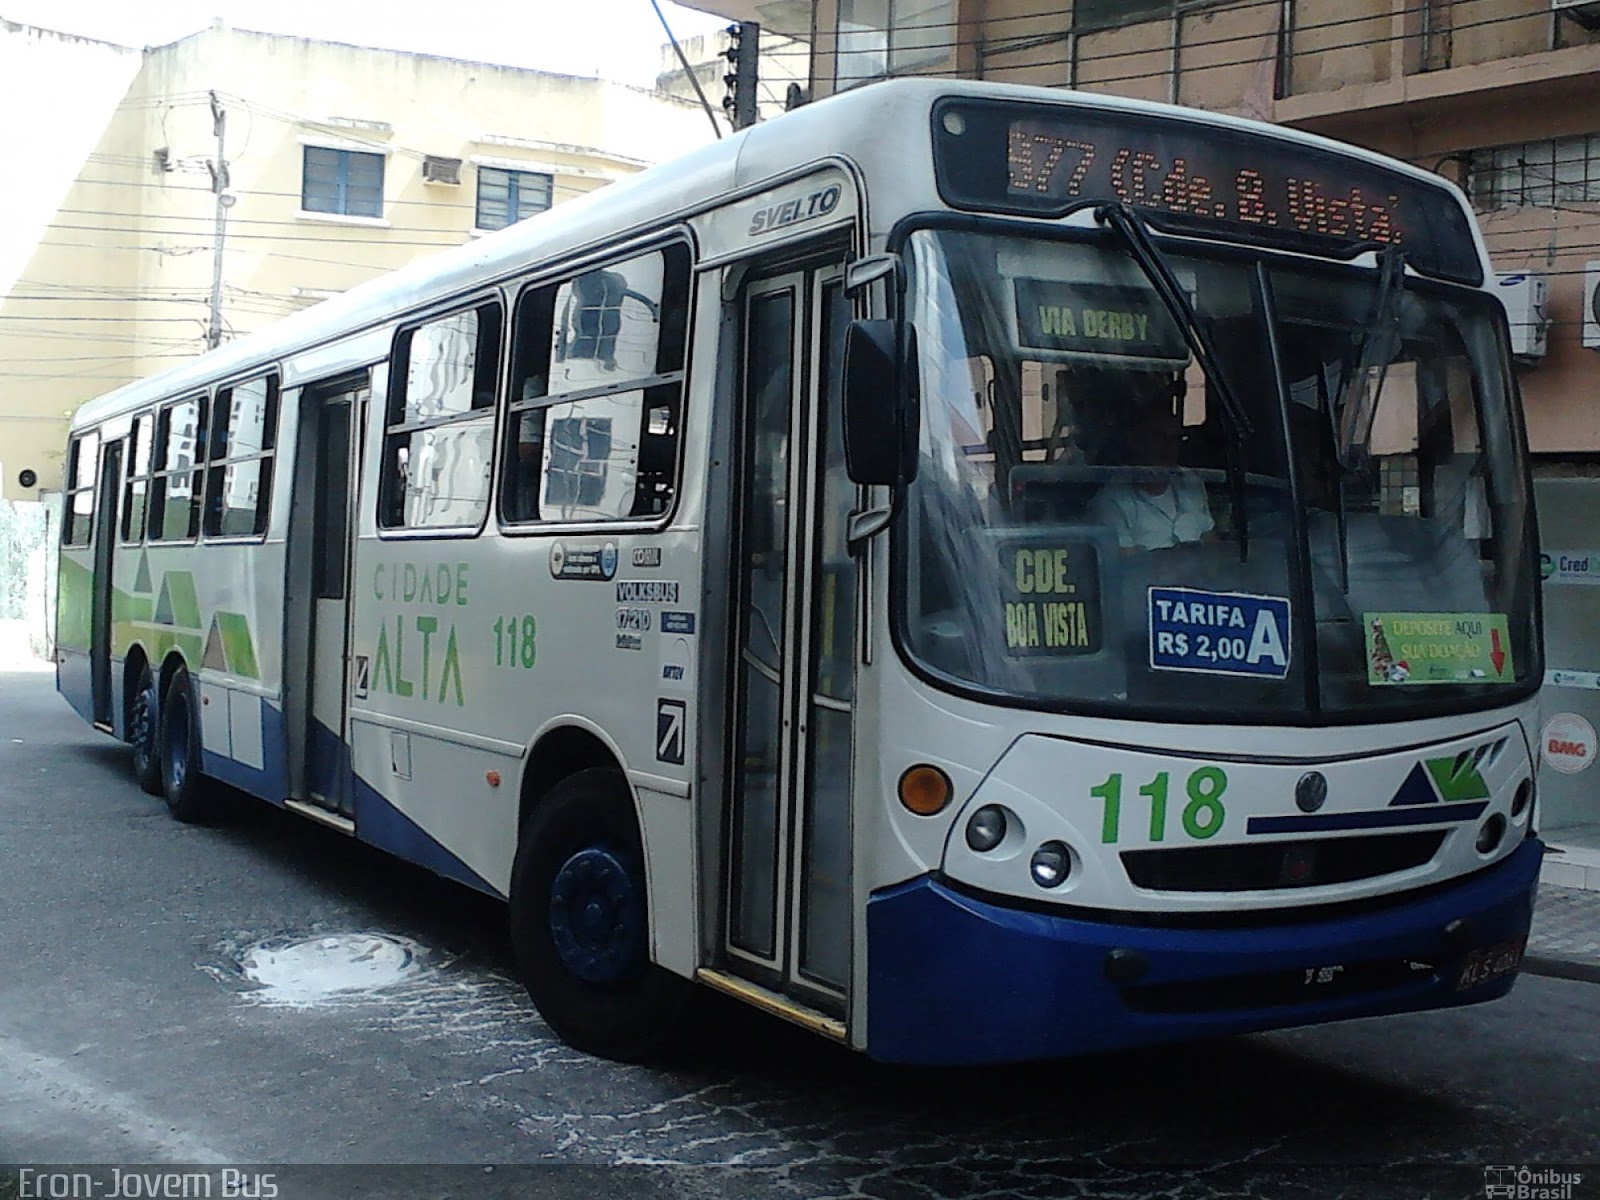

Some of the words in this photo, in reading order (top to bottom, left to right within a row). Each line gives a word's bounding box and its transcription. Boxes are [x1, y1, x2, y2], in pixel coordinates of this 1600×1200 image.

[749, 187, 840, 233] SVELTO
[1038, 305, 1077, 336] VIA
[1082, 308, 1149, 341] DERBY
[373, 562, 470, 606] CIDADE
[617, 583, 679, 603] VOLKSBUS
[1016, 549, 1076, 593] CDE.
[1006, 602, 1040, 648] BOA
[1044, 602, 1089, 647] VISTA
[1156, 600, 1246, 629] TARIFA
[1392, 619, 1452, 636] DEPOSITE
[1455, 620, 1483, 640] AQUI
[493, 614, 537, 669] 118
[1158, 631, 1189, 658] R$
[1196, 634, 1247, 663] 2,00
[1246, 609, 1287, 667] A
[371, 614, 465, 707] ALTA
[1547, 739, 1587, 757] BMG
[1089, 766, 1228, 844] 118
